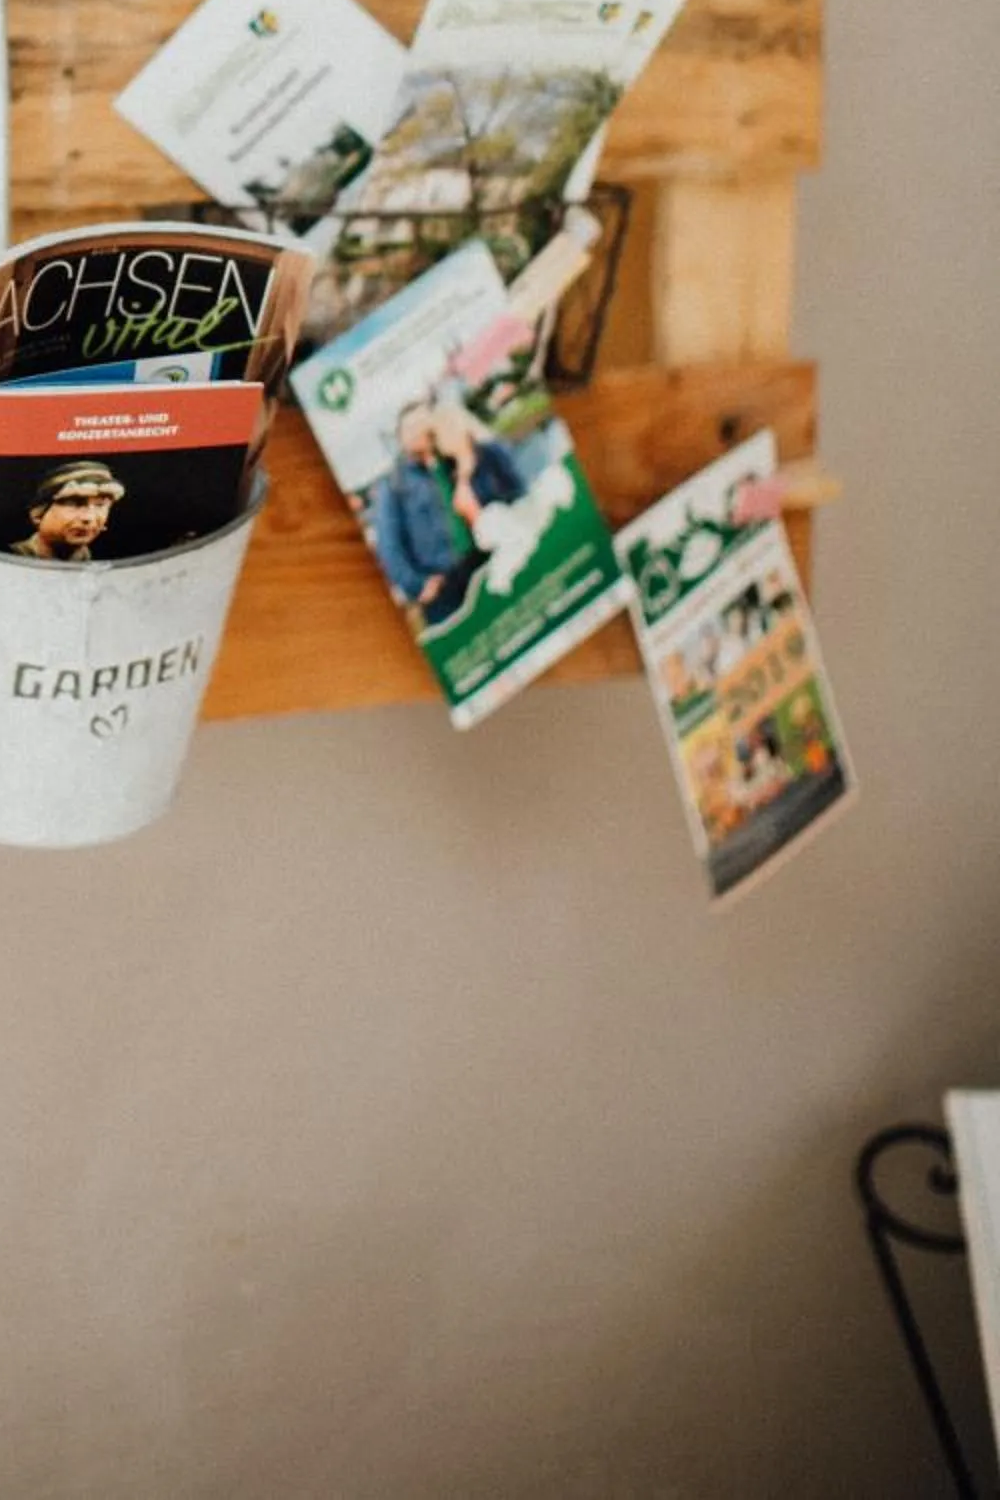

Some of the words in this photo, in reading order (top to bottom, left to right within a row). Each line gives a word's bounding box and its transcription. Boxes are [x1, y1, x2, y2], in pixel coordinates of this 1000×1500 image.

[82, 296, 280, 358] vital
[138, 412, 169, 424] UND
[12, 638, 203, 701] GARDEN
